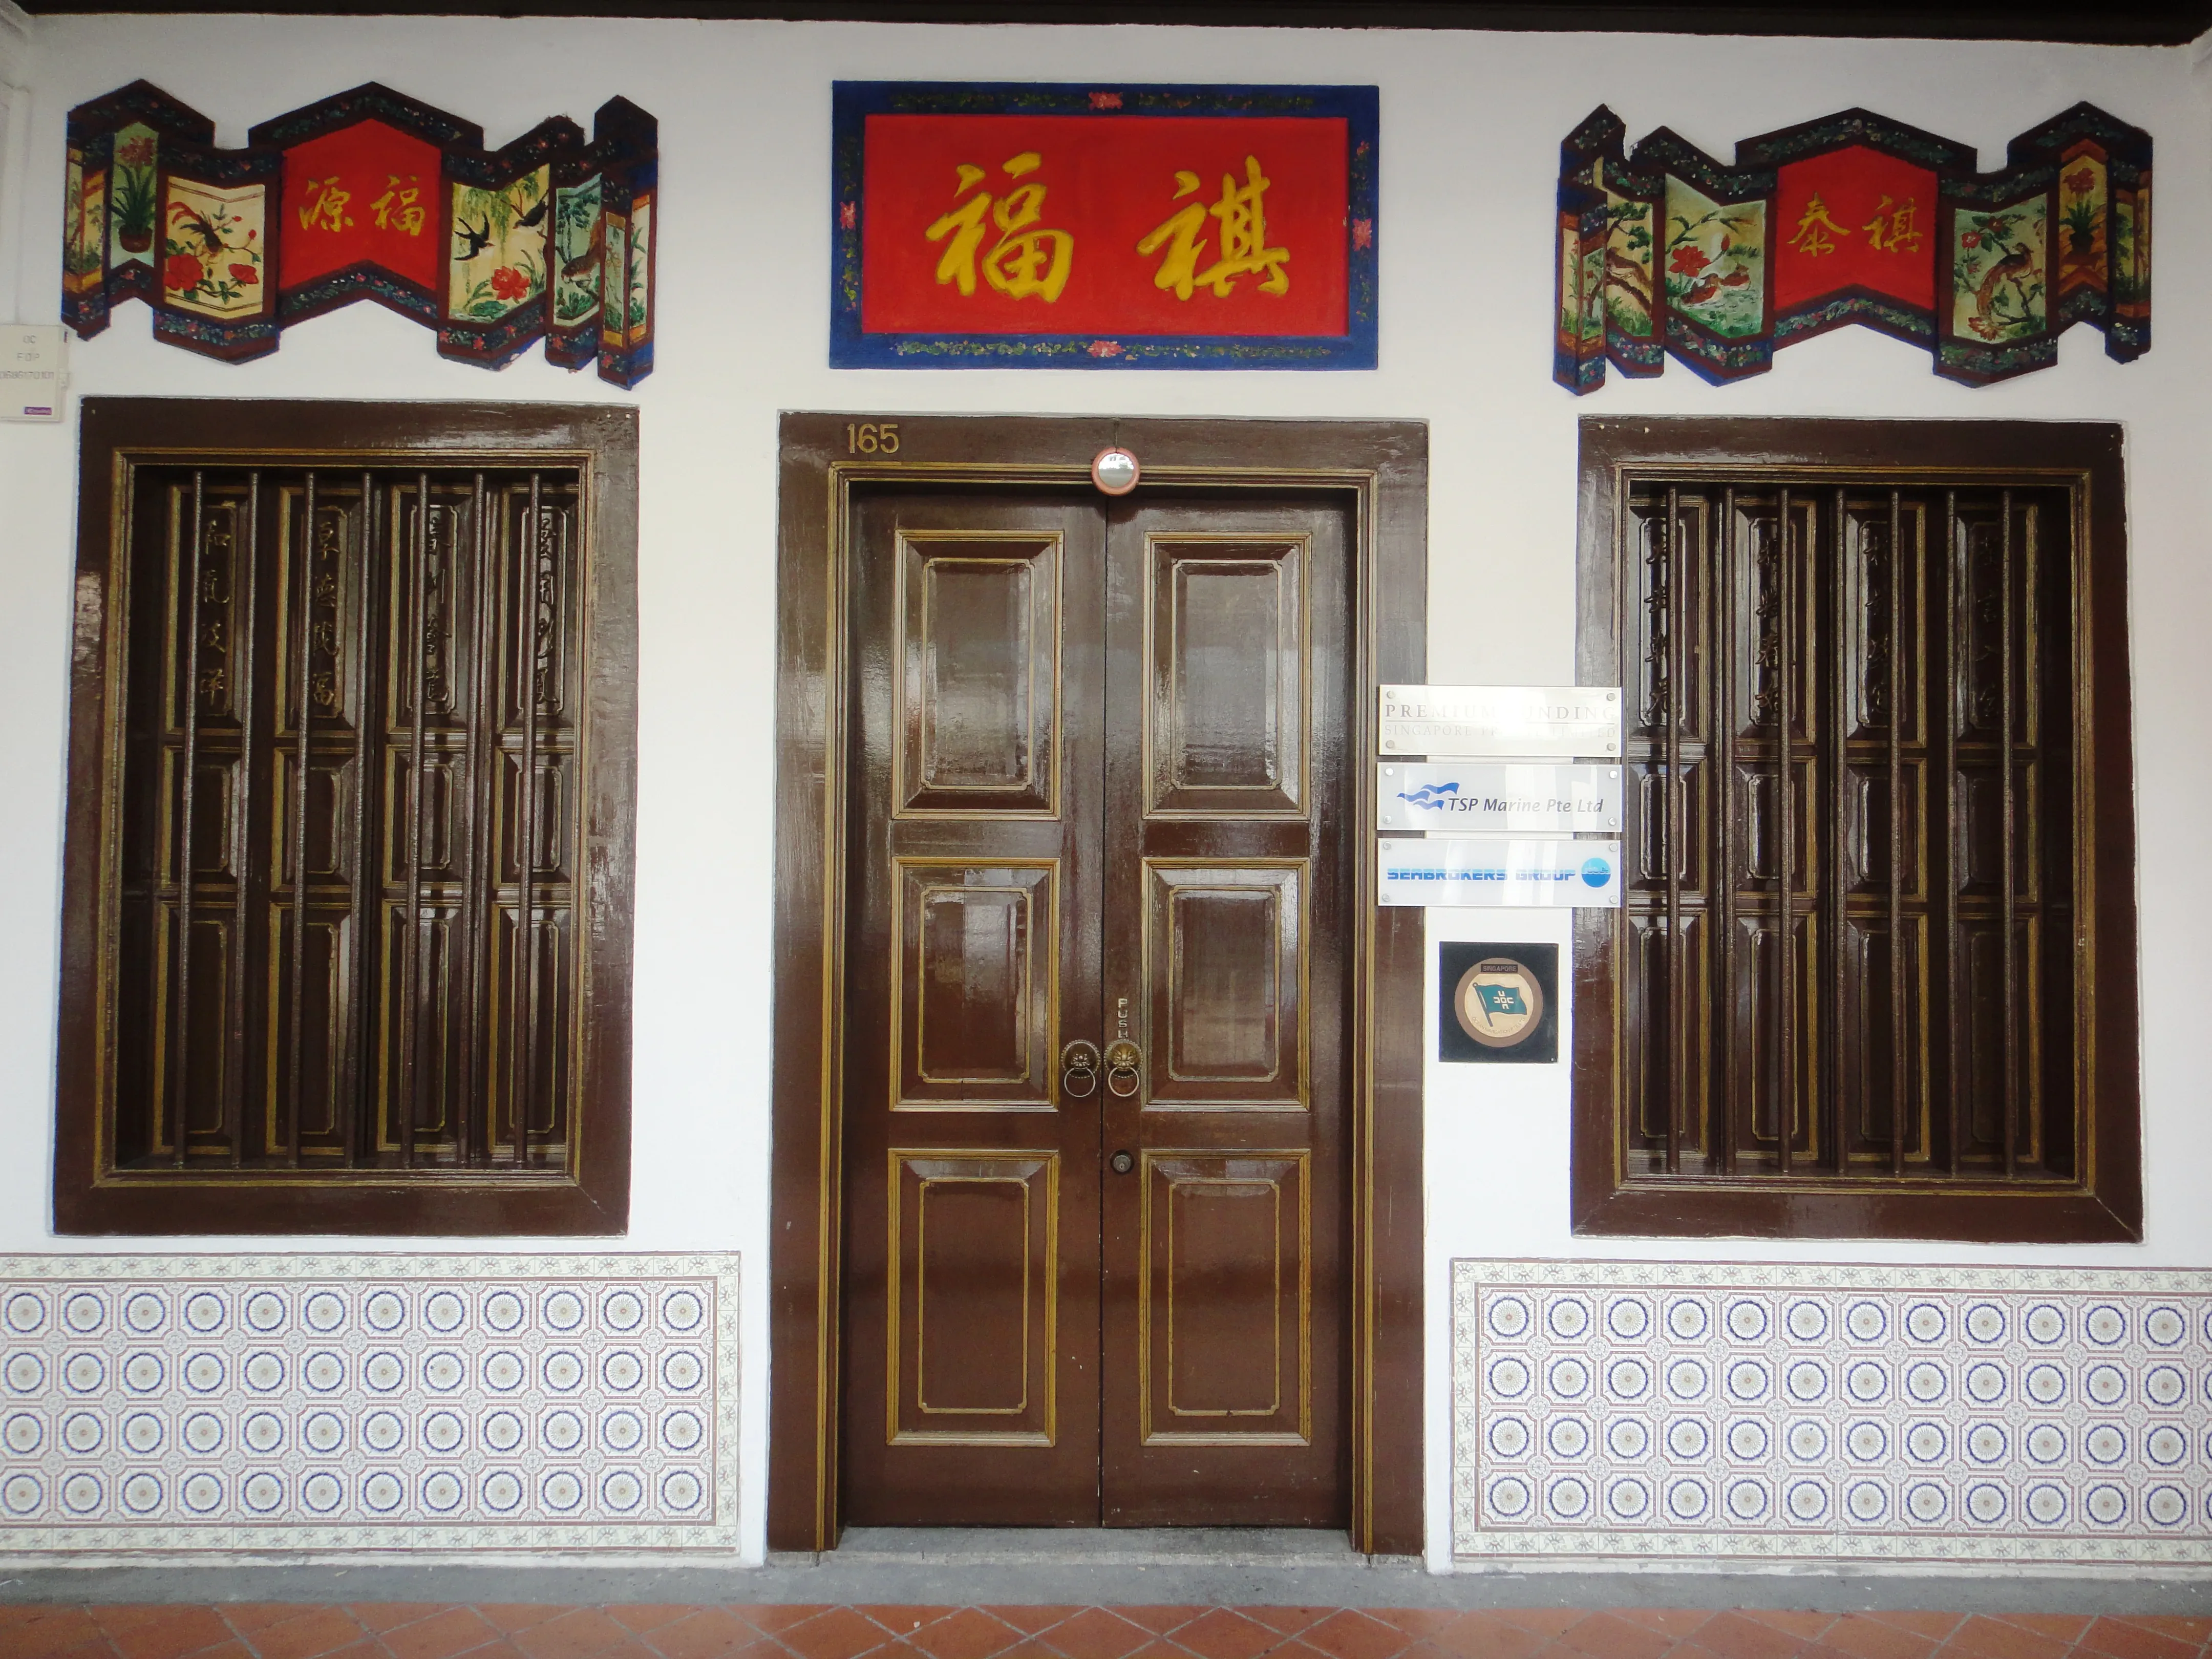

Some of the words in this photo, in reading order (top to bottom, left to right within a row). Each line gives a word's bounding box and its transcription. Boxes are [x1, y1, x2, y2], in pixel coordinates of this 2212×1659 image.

[847, 423, 899, 454] 165
[1385, 705, 1496, 718] PREMIUM
[1511, 706, 1615, 720] UNDING
[1385, 725, 1472, 736] SINGAPORE
[1448, 798, 1478, 812] TSP
[1483, 798, 1540, 812] Marine
[1546, 799, 1571, 812] Pte
[1577, 799, 1604, 813] Ltd
[1387, 868, 1508, 881] SEABROKERS
[1515, 869, 1576, 881] GROUP
[1118, 998, 1128, 1038] PUSH
